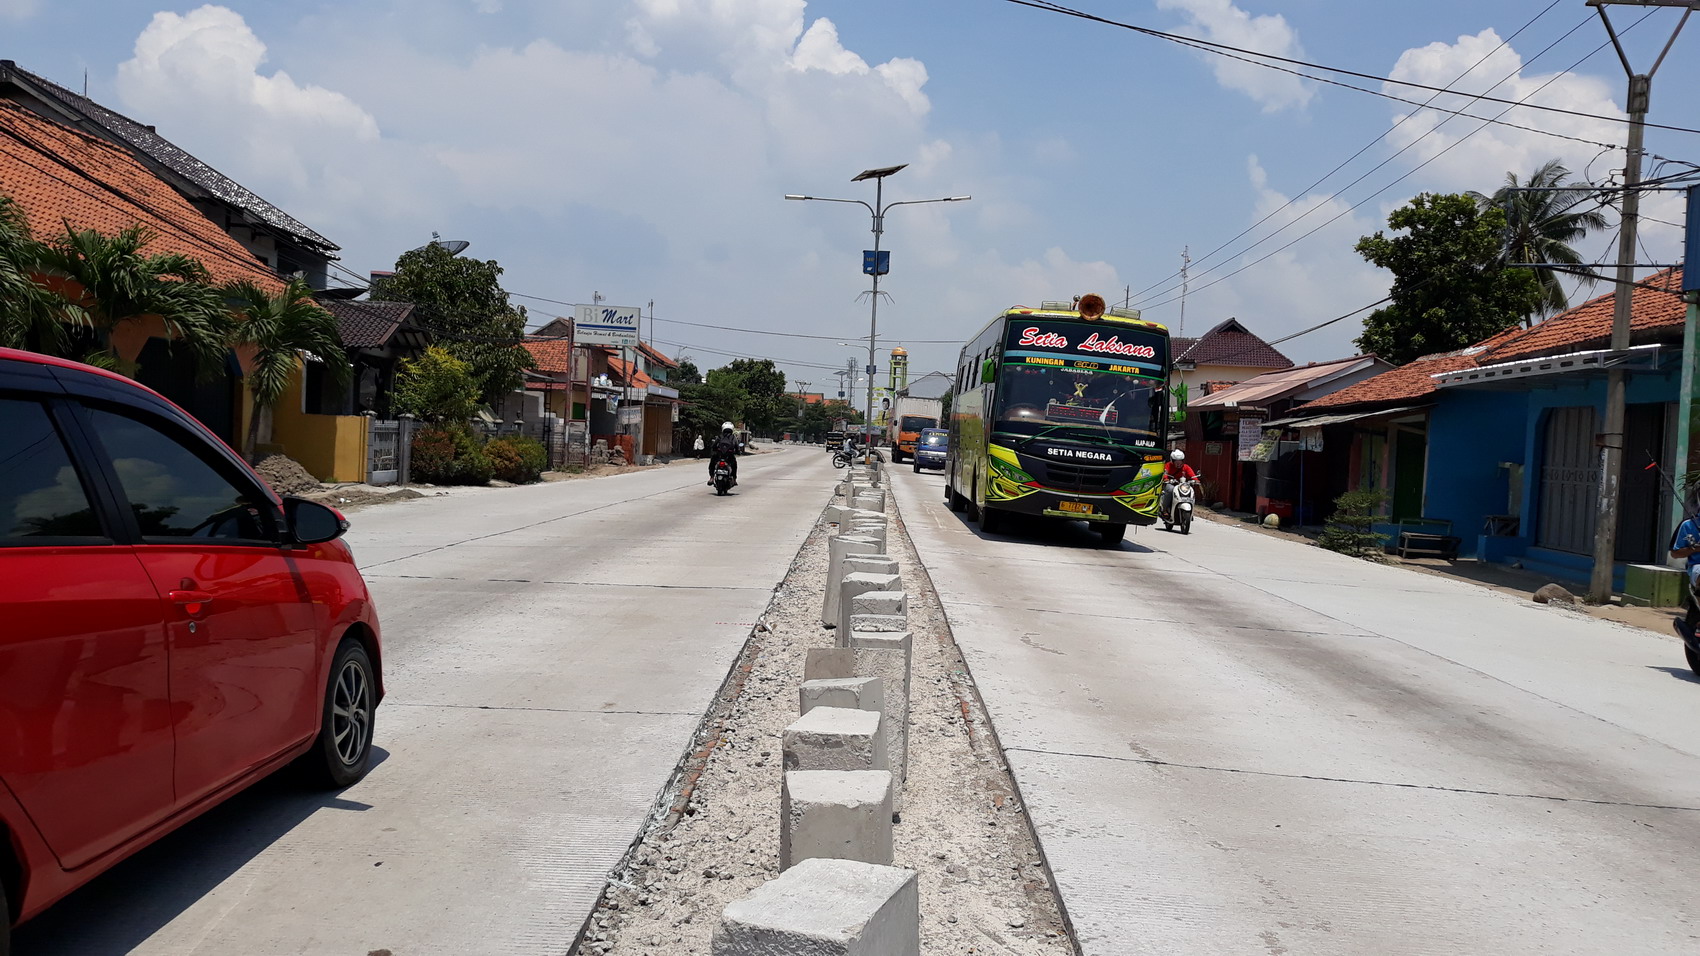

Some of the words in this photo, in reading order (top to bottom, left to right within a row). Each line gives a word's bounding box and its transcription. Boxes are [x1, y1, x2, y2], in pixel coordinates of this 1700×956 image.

[582, 307, 598, 323] Bi
[602, 308, 633, 324] Mart
[1018, 326, 1068, 349] Setia
[1077, 332, 1155, 359] Laksana
[1025, 356, 1065, 366] KUNINGAN
[1108, 364, 1140, 374] JAKARTA
[1047, 447, 1073, 457] SETIA
[1075, 450, 1112, 461] NEGARA
